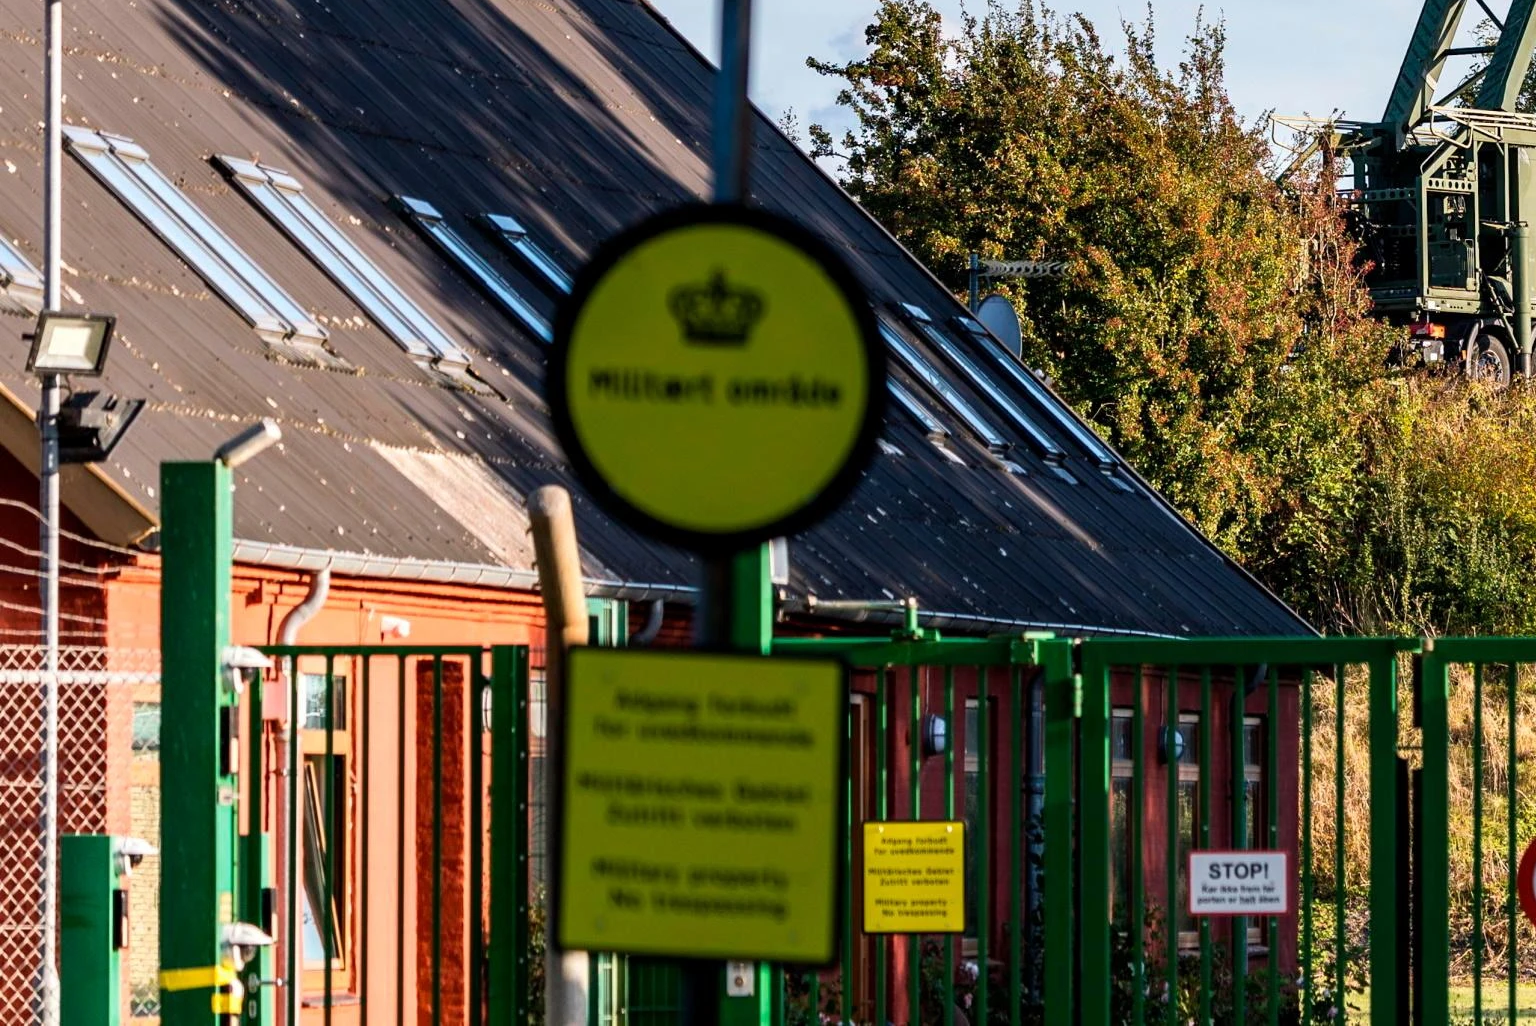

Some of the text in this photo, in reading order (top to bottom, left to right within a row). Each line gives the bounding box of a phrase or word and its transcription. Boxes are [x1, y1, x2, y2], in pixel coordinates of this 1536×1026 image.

[1209, 862, 1268, 879] STOP!
[911, 878, 949, 886] verboten
[911, 898, 947, 907] property
[882, 909, 894, 917] No
